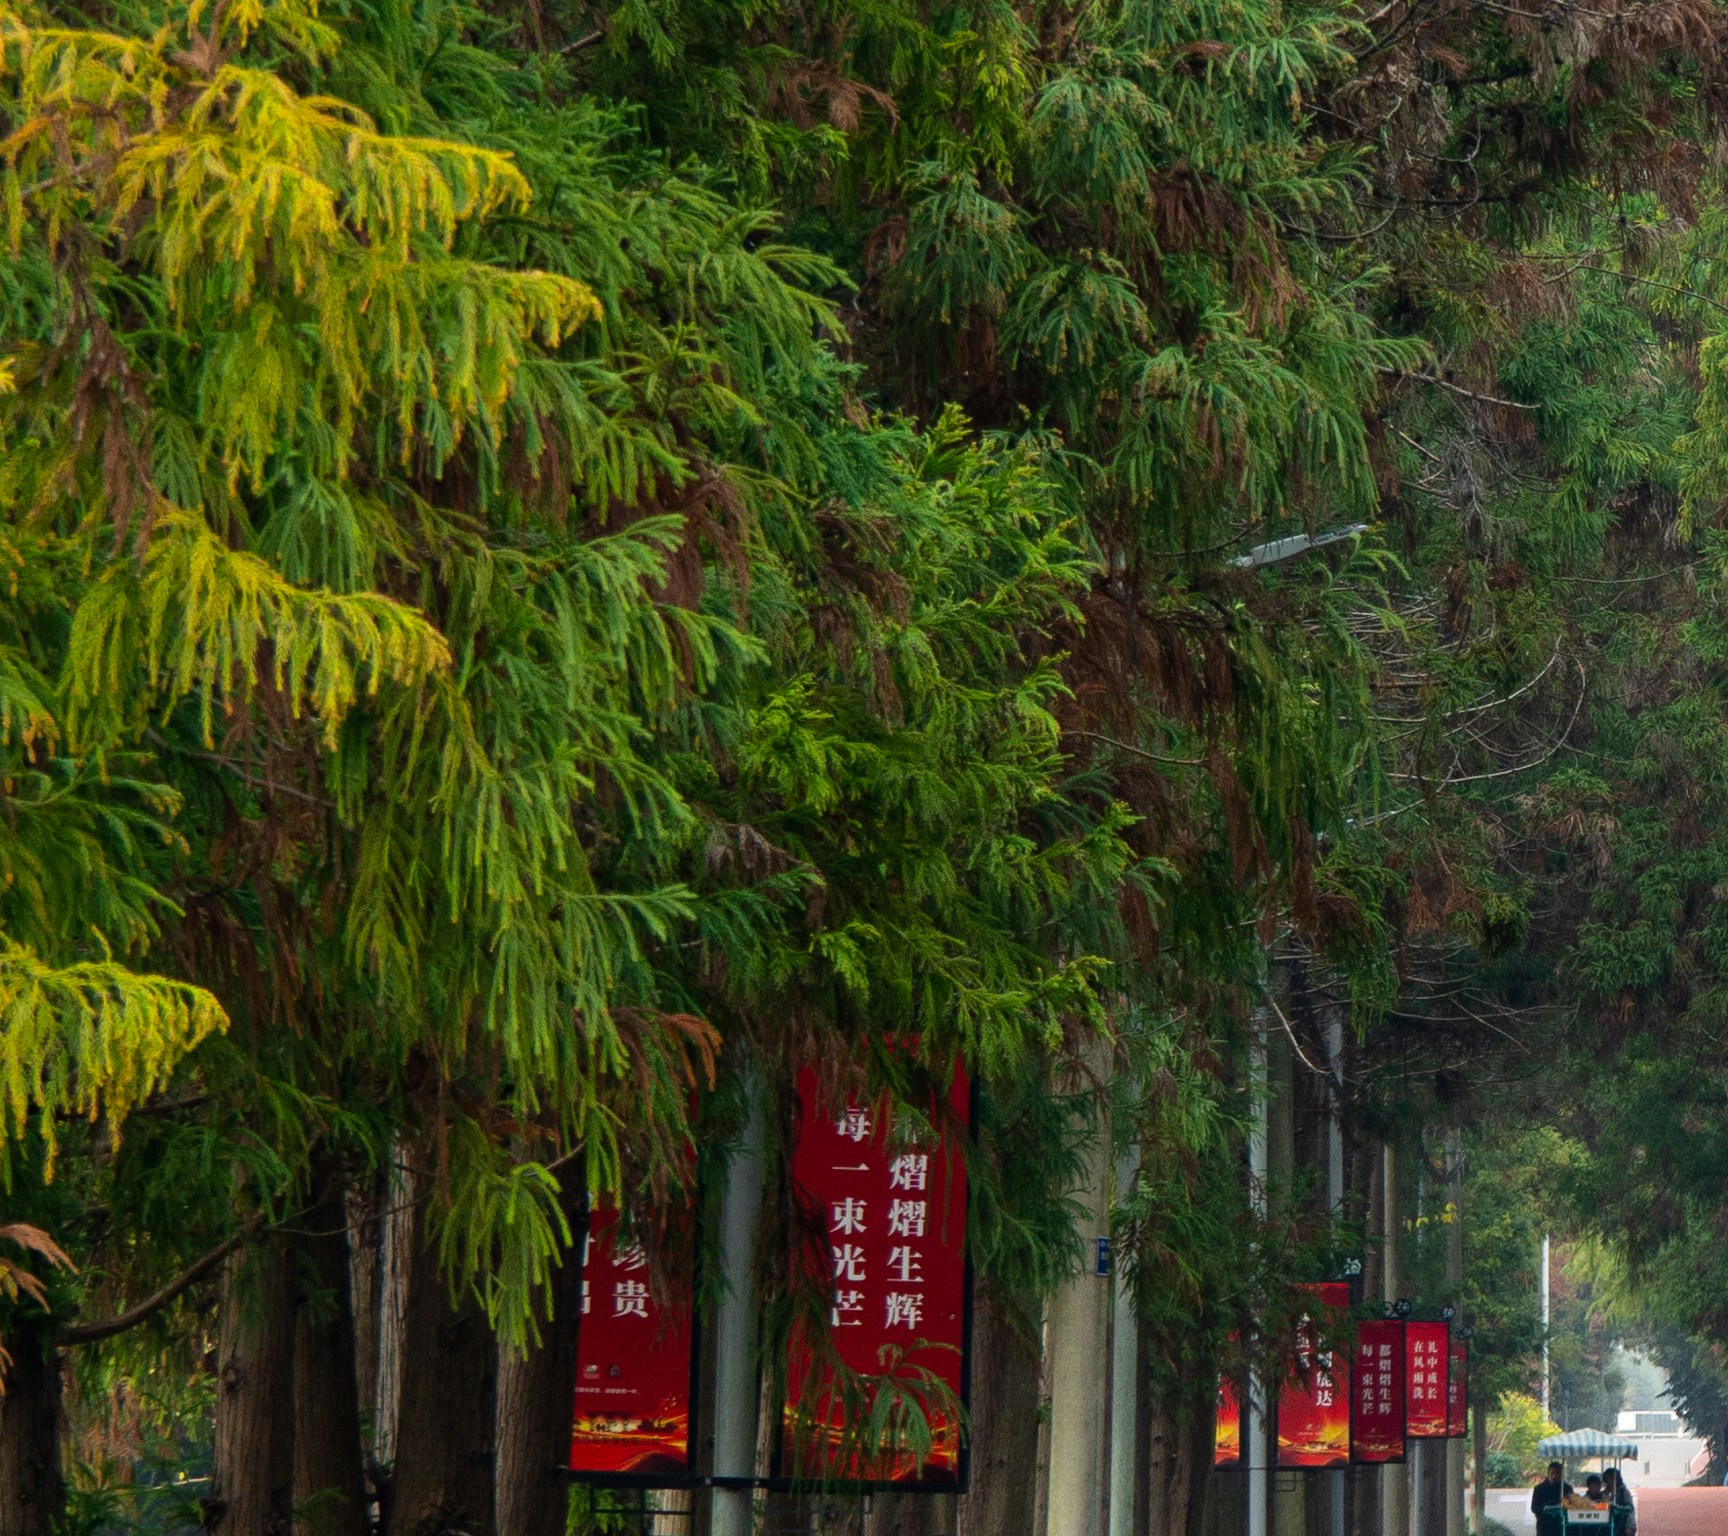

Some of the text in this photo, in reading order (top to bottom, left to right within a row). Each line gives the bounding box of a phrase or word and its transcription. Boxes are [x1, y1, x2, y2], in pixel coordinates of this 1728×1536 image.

[830, 1107, 870, 1327] 每一束光芒
[884, 1118, 928, 1330] 熠熠生辉
[1362, 1344, 1374, 1415] 每一束光芒
[1379, 1344, 1391, 1415] 都熠熠生辉
